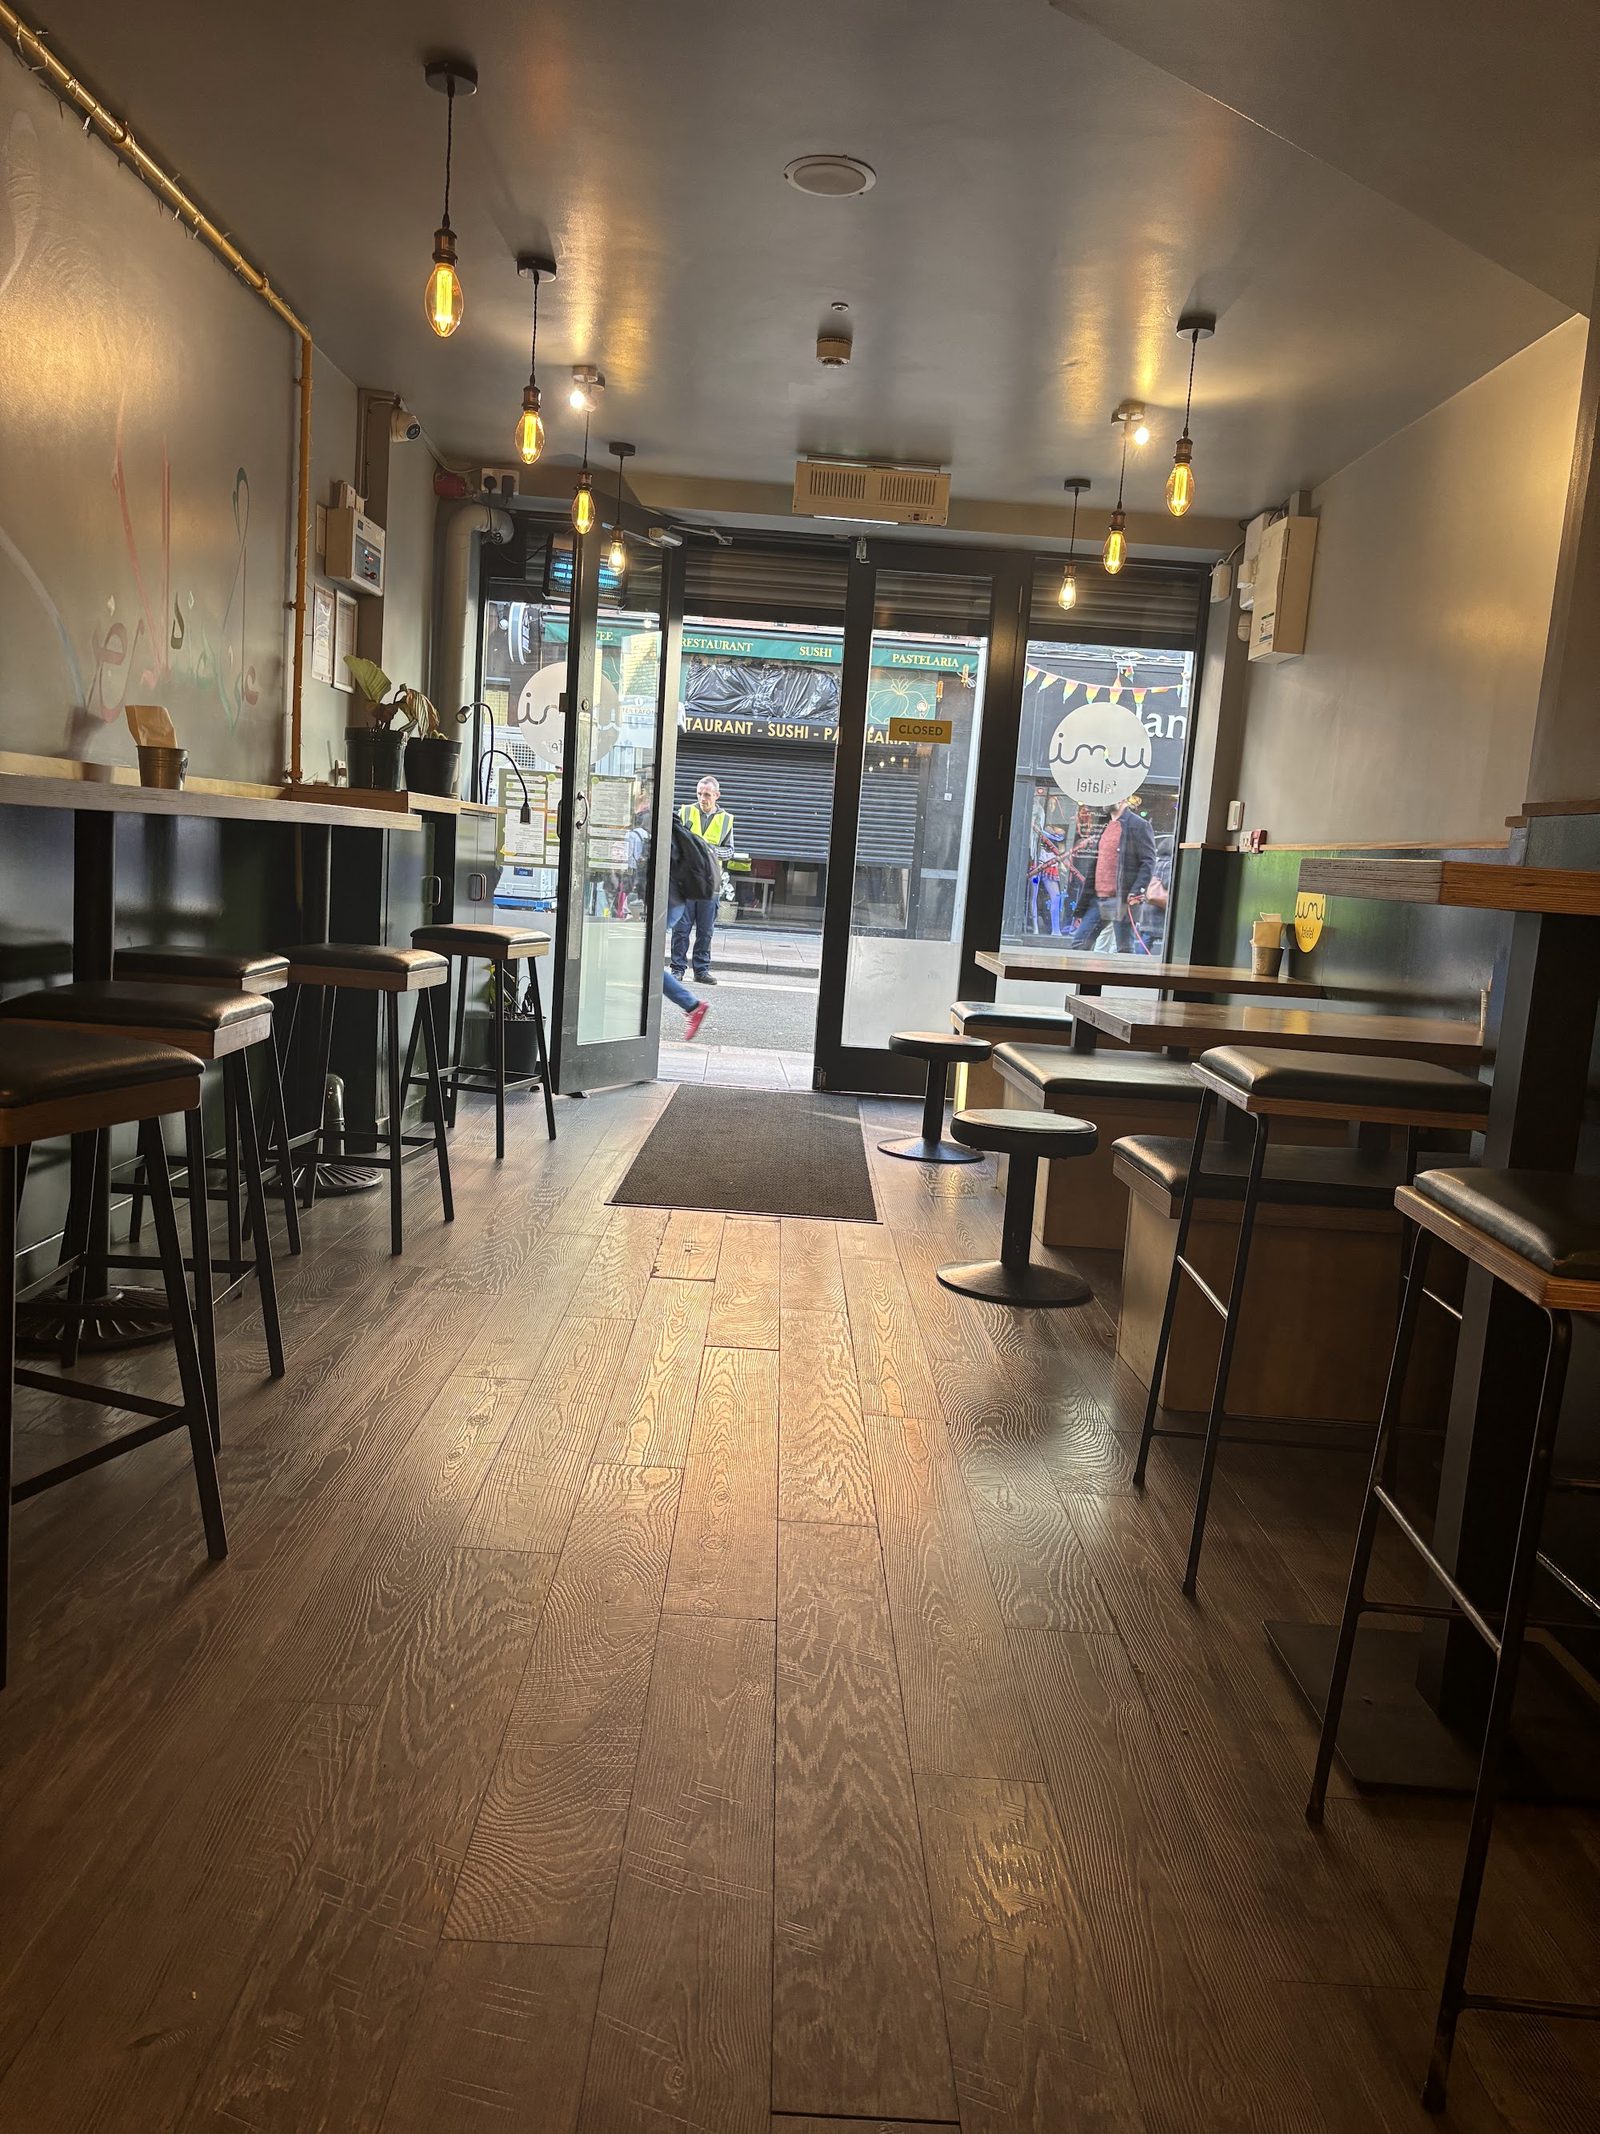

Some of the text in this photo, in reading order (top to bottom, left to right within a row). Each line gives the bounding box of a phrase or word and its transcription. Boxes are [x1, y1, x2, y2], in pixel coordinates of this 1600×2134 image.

[681, 638, 959, 668] RESTAURANT SUSHI PASTELARIA
[685, 717, 753, 735] TAURANT
[767, 722, 808, 739] SUSHI
[898, 725, 943, 736] CLOSED
